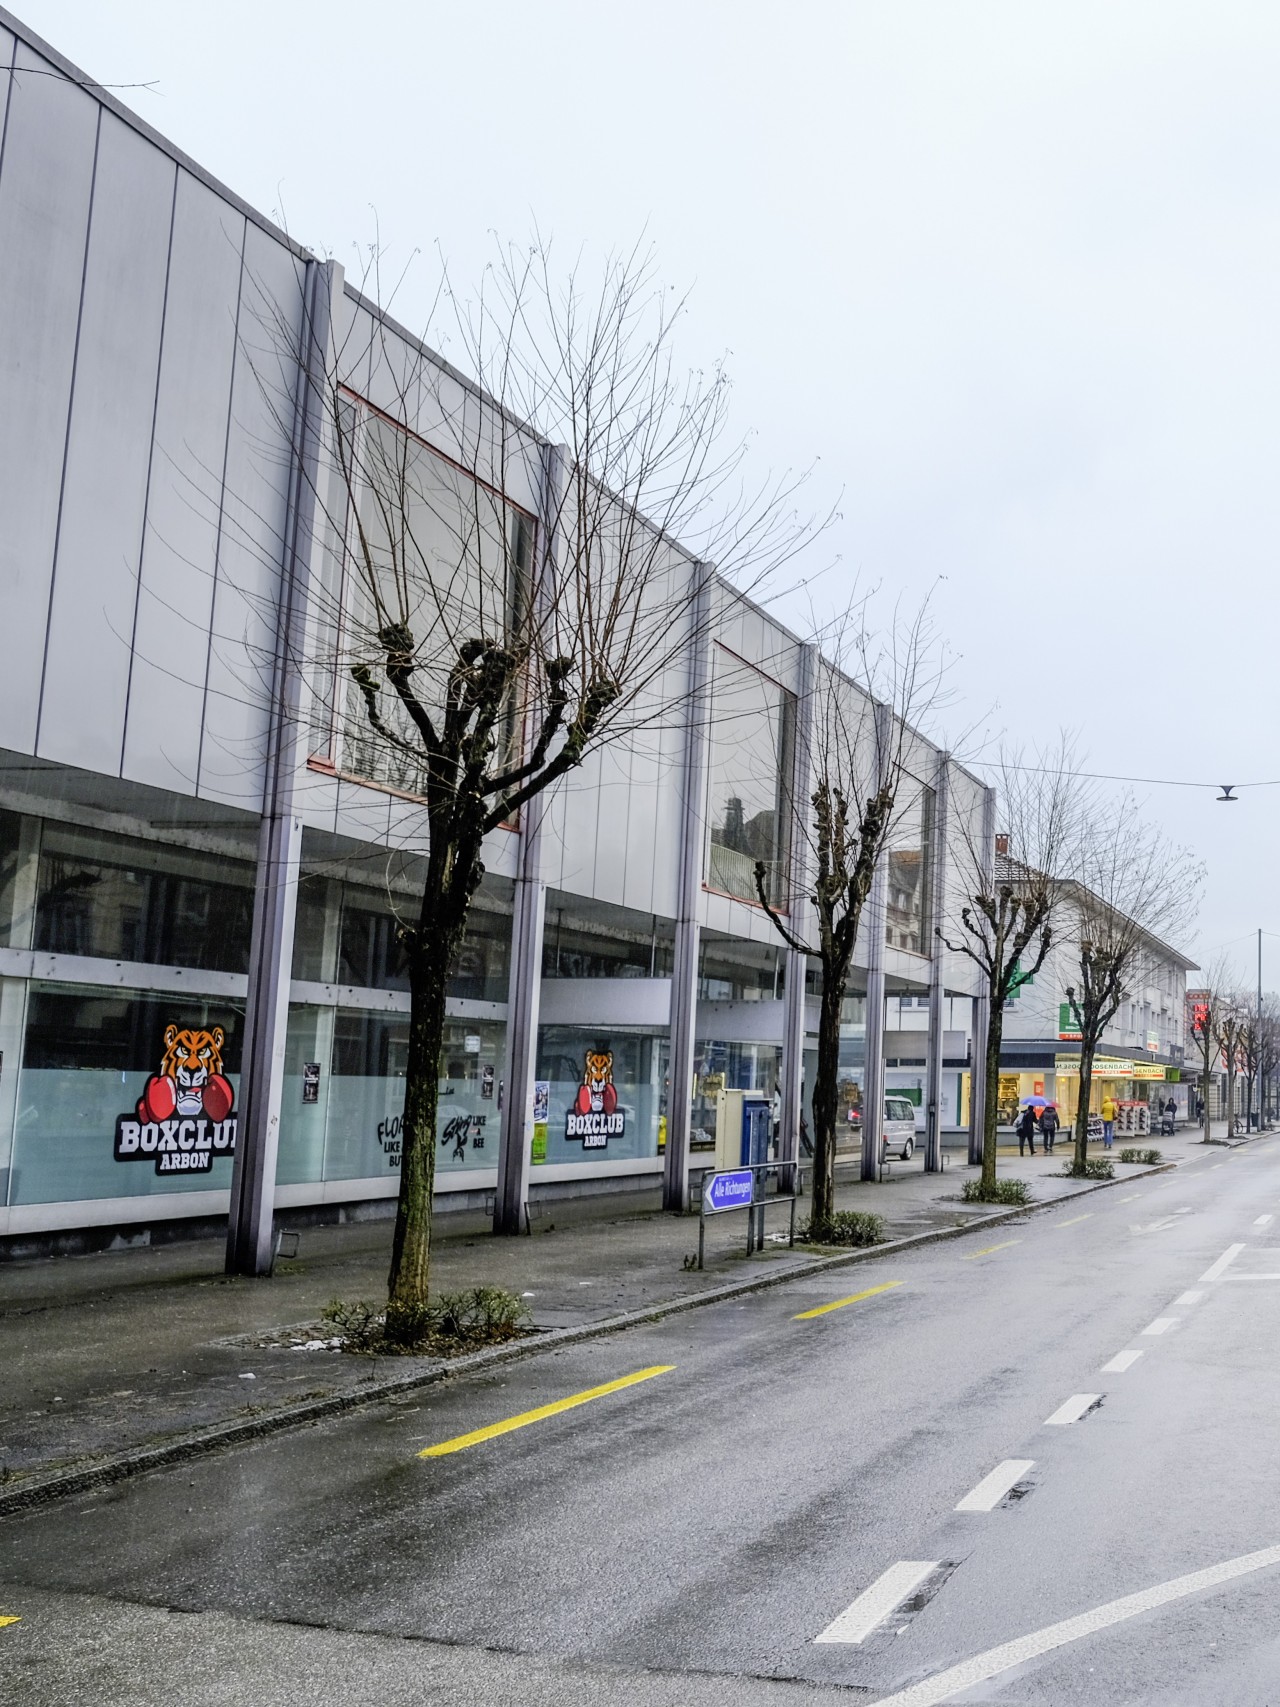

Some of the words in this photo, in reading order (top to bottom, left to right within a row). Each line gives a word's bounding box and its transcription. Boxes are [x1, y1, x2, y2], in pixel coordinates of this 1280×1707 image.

[473, 1115, 486, 1126] LIKE
[566, 1113, 624, 1135] BOXCLUB
[384, 1141, 400, 1153] LIKE
[473, 1138, 485, 1148] BEE
[584, 1135, 607, 1147] ARBON
[160, 1152, 210, 1170] ARBON
[714, 1181, 725, 1198] Alle
[725, 1180, 750, 1197] Richtungen
